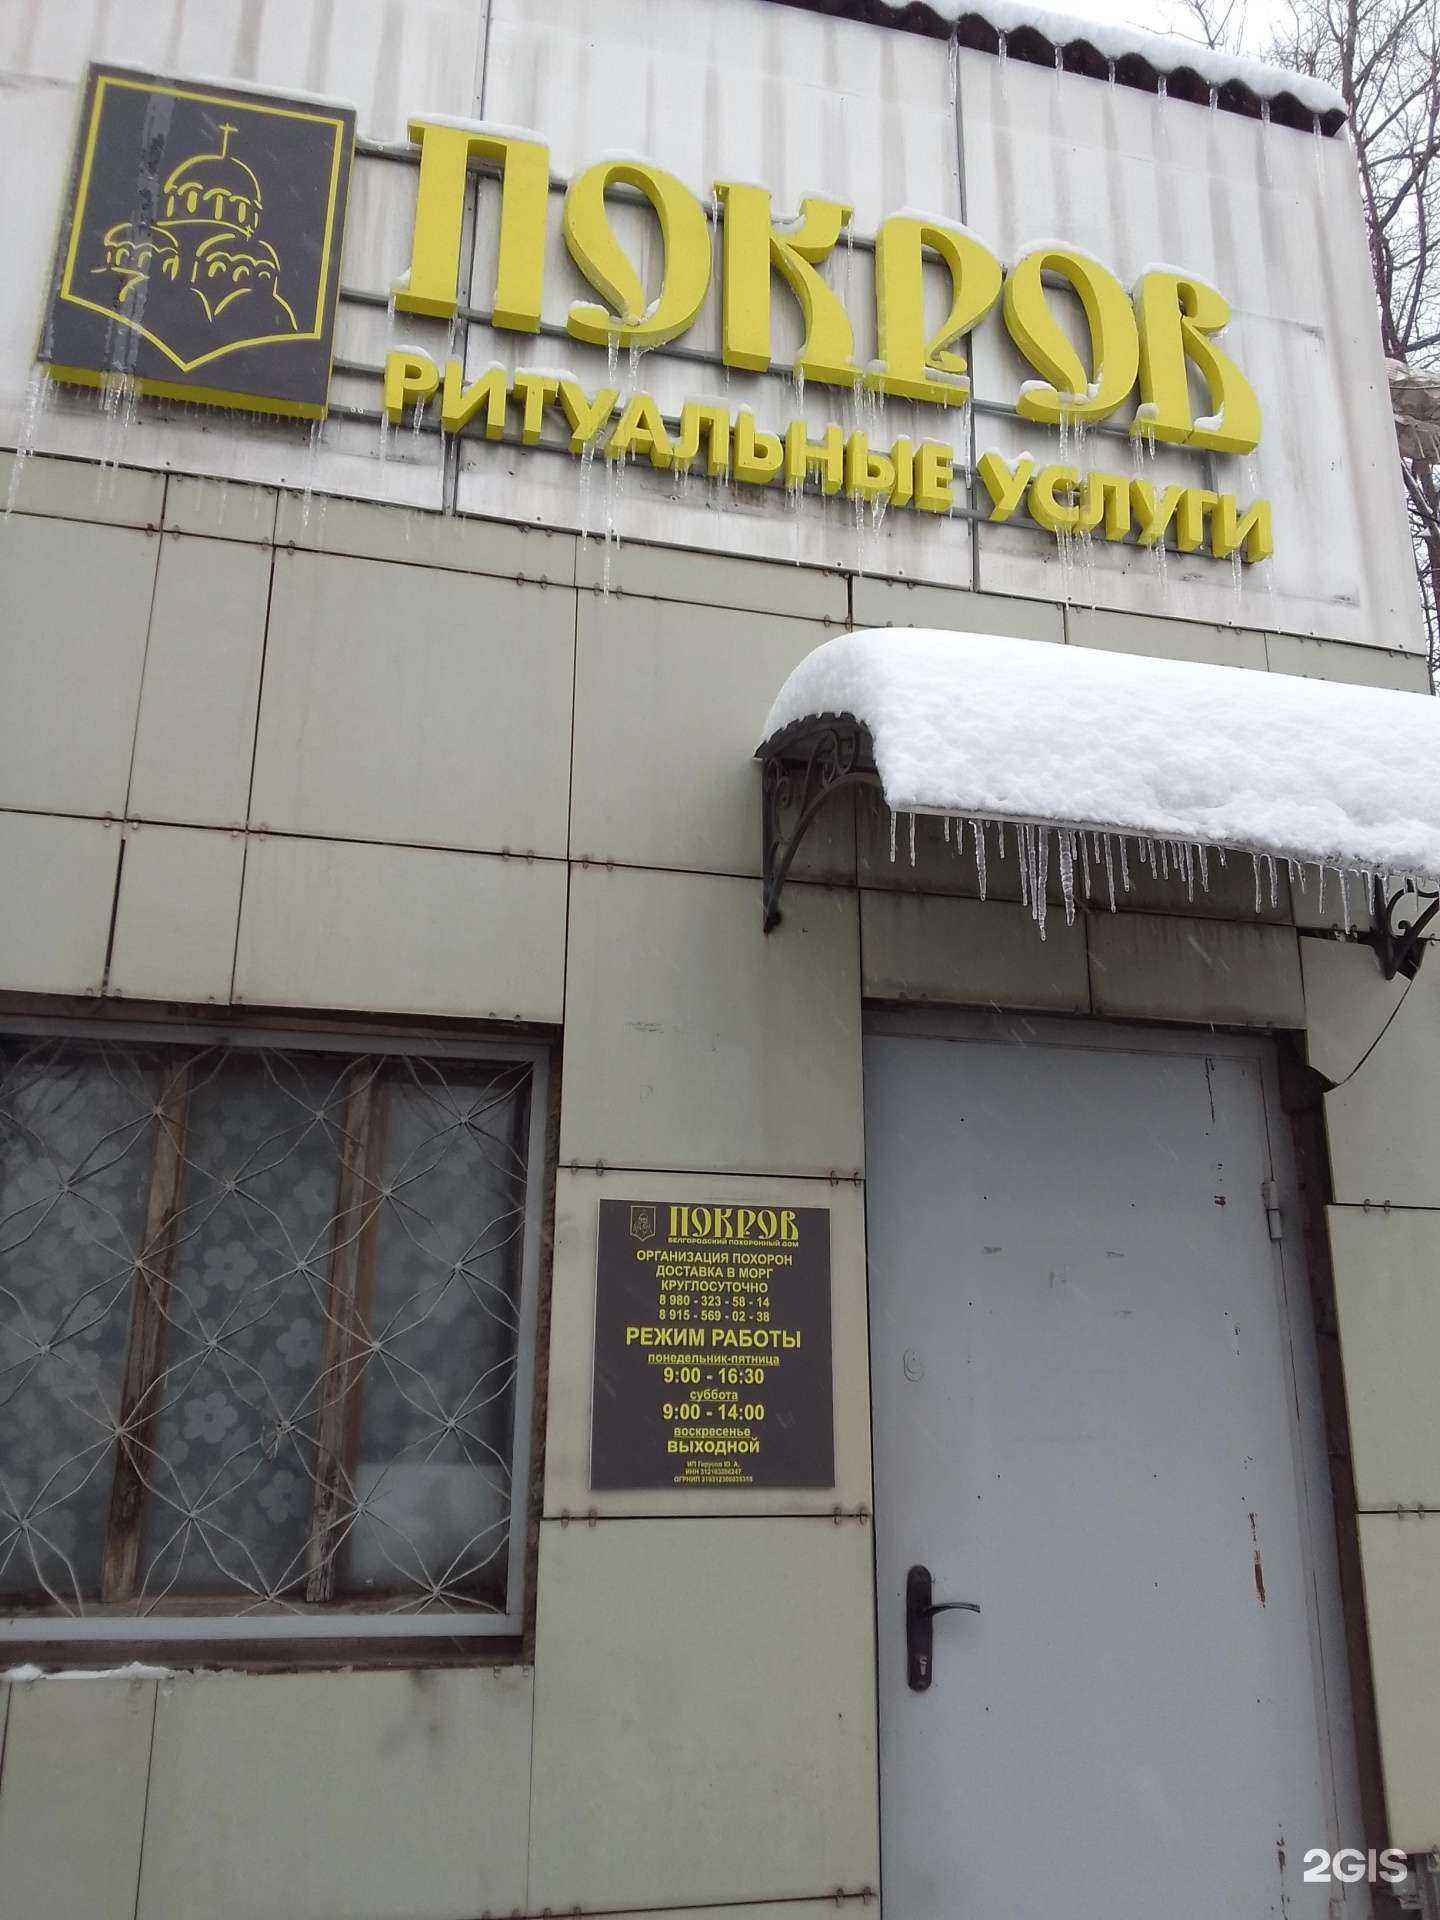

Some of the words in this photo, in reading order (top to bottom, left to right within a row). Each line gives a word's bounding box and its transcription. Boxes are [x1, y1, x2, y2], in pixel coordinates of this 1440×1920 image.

[391, 117, 1261, 455] ПОКРОВ
[385, 347, 954, 513] РИТУАЛЬНЫЕ
[976, 452, 1274, 564] УСЛУГИ
[669, 1205, 799, 1241] ПОКРОВ
[636, 1250, 729, 1265] ОРГАНИЗАЦИЯ
[732, 1253, 793, 1266] ПОХОРОН
[656, 1265, 724, 1278] ДОСТАВКА
[727, 1267, 736, 1278] В
[738, 1268, 774, 1279] МОРГ
[661, 1280, 769, 1294] КРУГЛОСУТОЧНО
[626, 1326, 705, 1346] РЕЖИМ
[711, 1328, 801, 1348] РАБОТЫ
[648, 1353, 780, 1366] понедельник-пятница
[663, 1366, 701, 1384] 9:00
[718, 1367, 765, 1384] 16:30
[690, 1388, 738, 1401] суббота
[662, 1403, 701, 1420] 9:00
[718, 1404, 765, 1421] 14:00
[673, 1426, 751, 1438] воскресенье
[667, 1437, 760, 1456] ВЫХОДНОЙ
